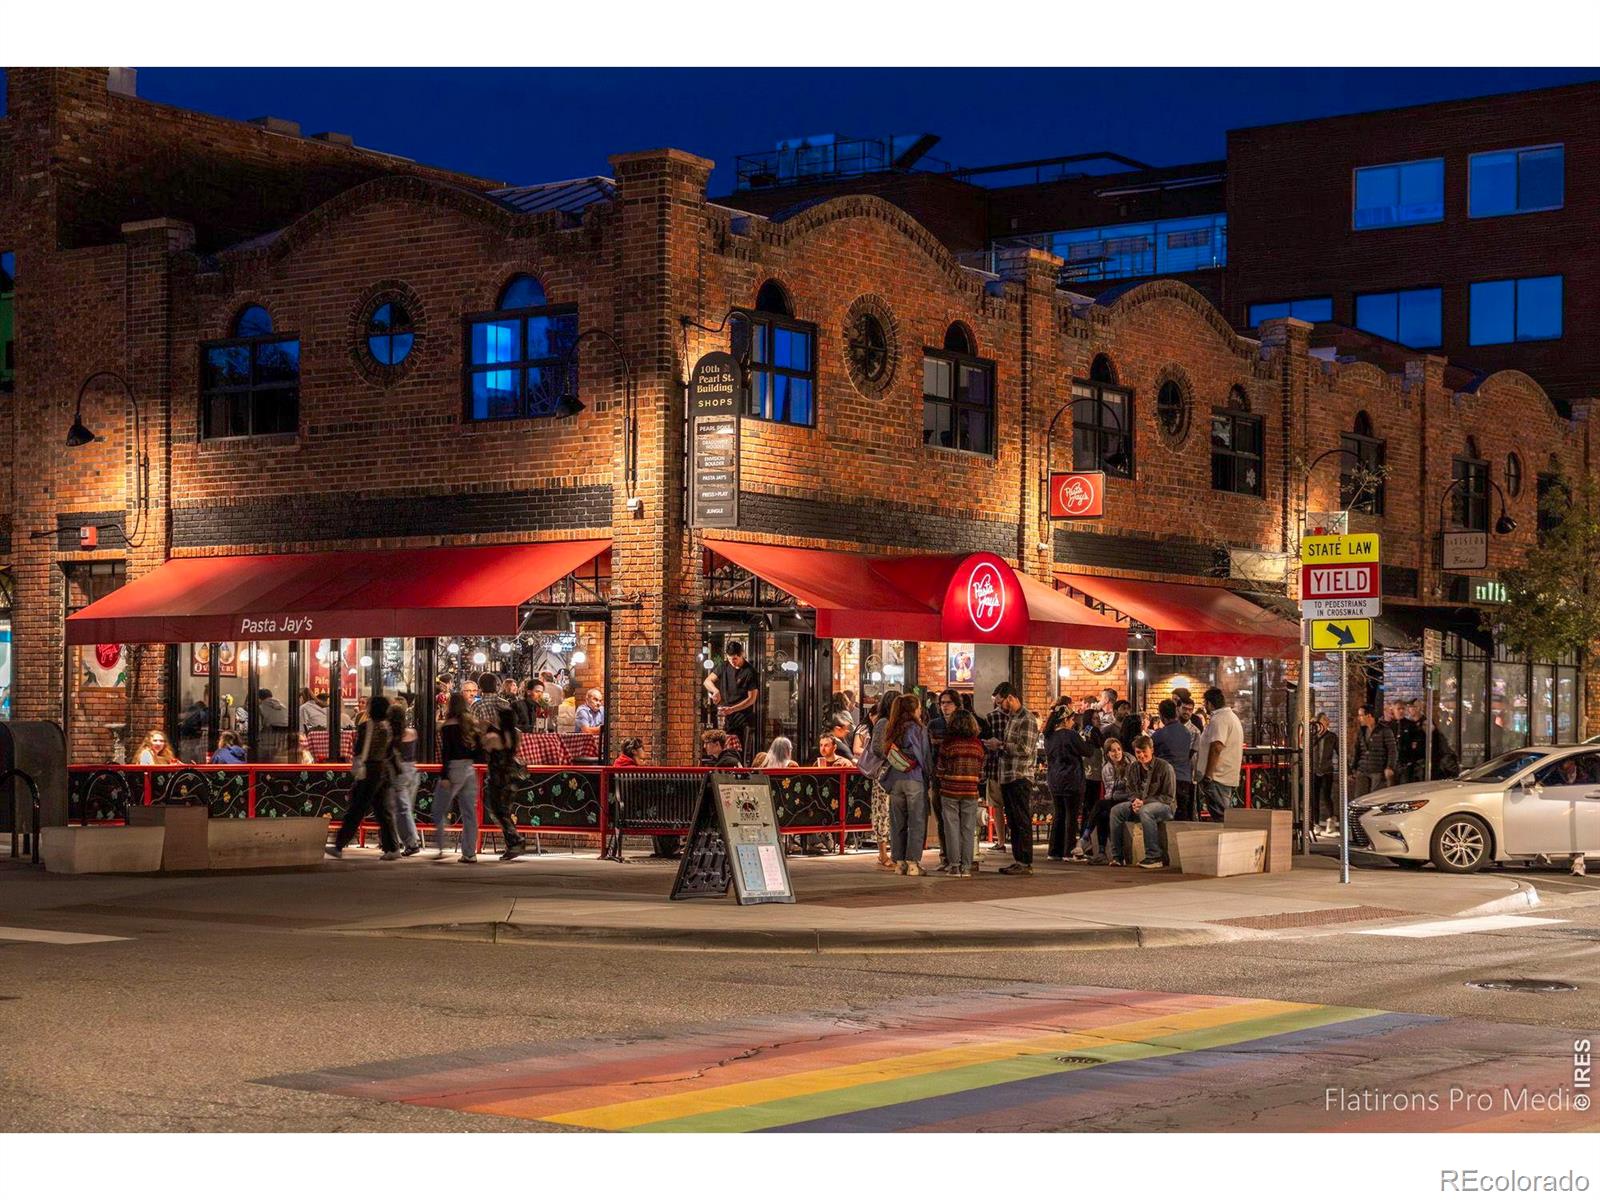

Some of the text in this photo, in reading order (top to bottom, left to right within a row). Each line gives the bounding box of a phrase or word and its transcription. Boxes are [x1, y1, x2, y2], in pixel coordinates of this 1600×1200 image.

[701, 365, 720, 373] 10th
[698, 373, 735, 384] Pearl St.
[697, 383, 733, 394] Building
[698, 398, 732, 407] SHOPS
[1064, 482, 1082, 497] Pasta
[1308, 541, 1372, 557] STATE LAW
[973, 574, 993, 599] Pasta
[1313, 570, 1368, 592] YIELD
[1314, 600, 1367, 609] TO PEDESTRIANS
[1326, 609, 1364, 617] CROSSWALK
[241, 616, 313, 634] Pasta Jay's
